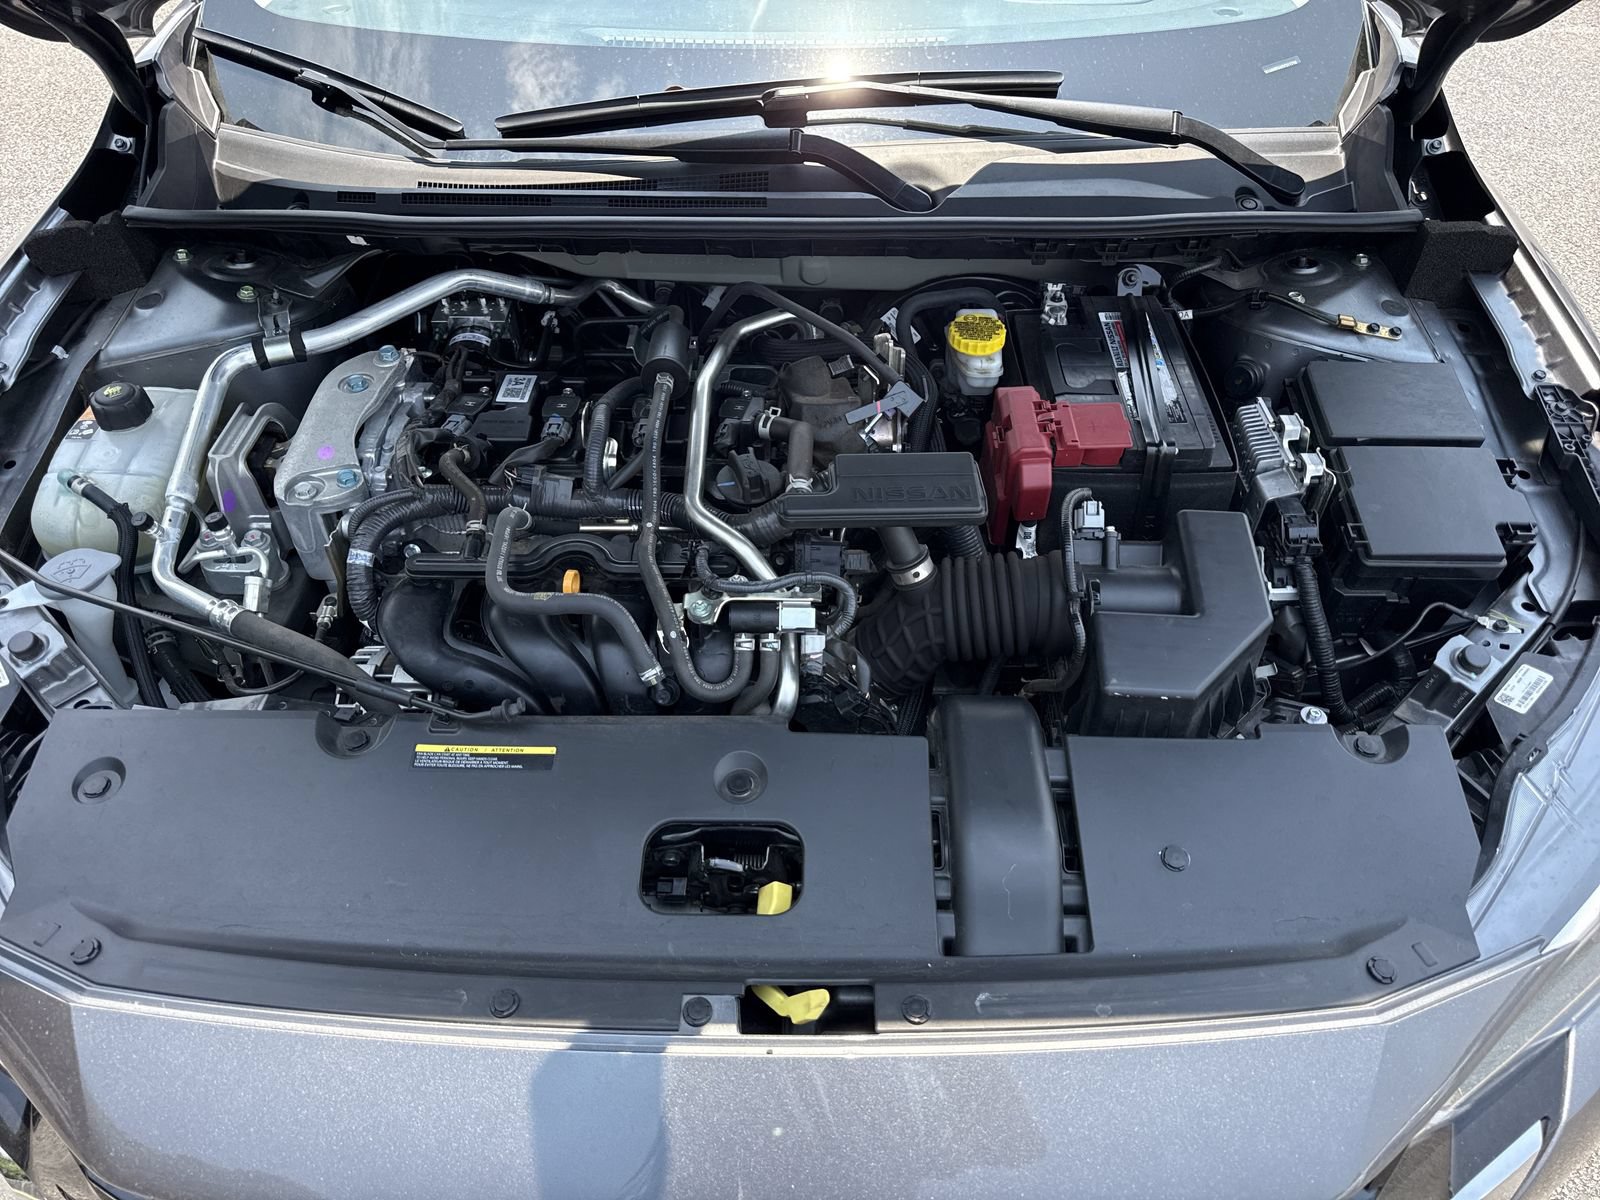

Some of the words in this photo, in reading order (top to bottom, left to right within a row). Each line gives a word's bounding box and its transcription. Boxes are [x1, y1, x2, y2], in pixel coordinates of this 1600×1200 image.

[1103, 322, 1117, 345] NISSAN
[1111, 345, 1124, 367] RENAULT
[853, 484, 974, 503] NISSAN
